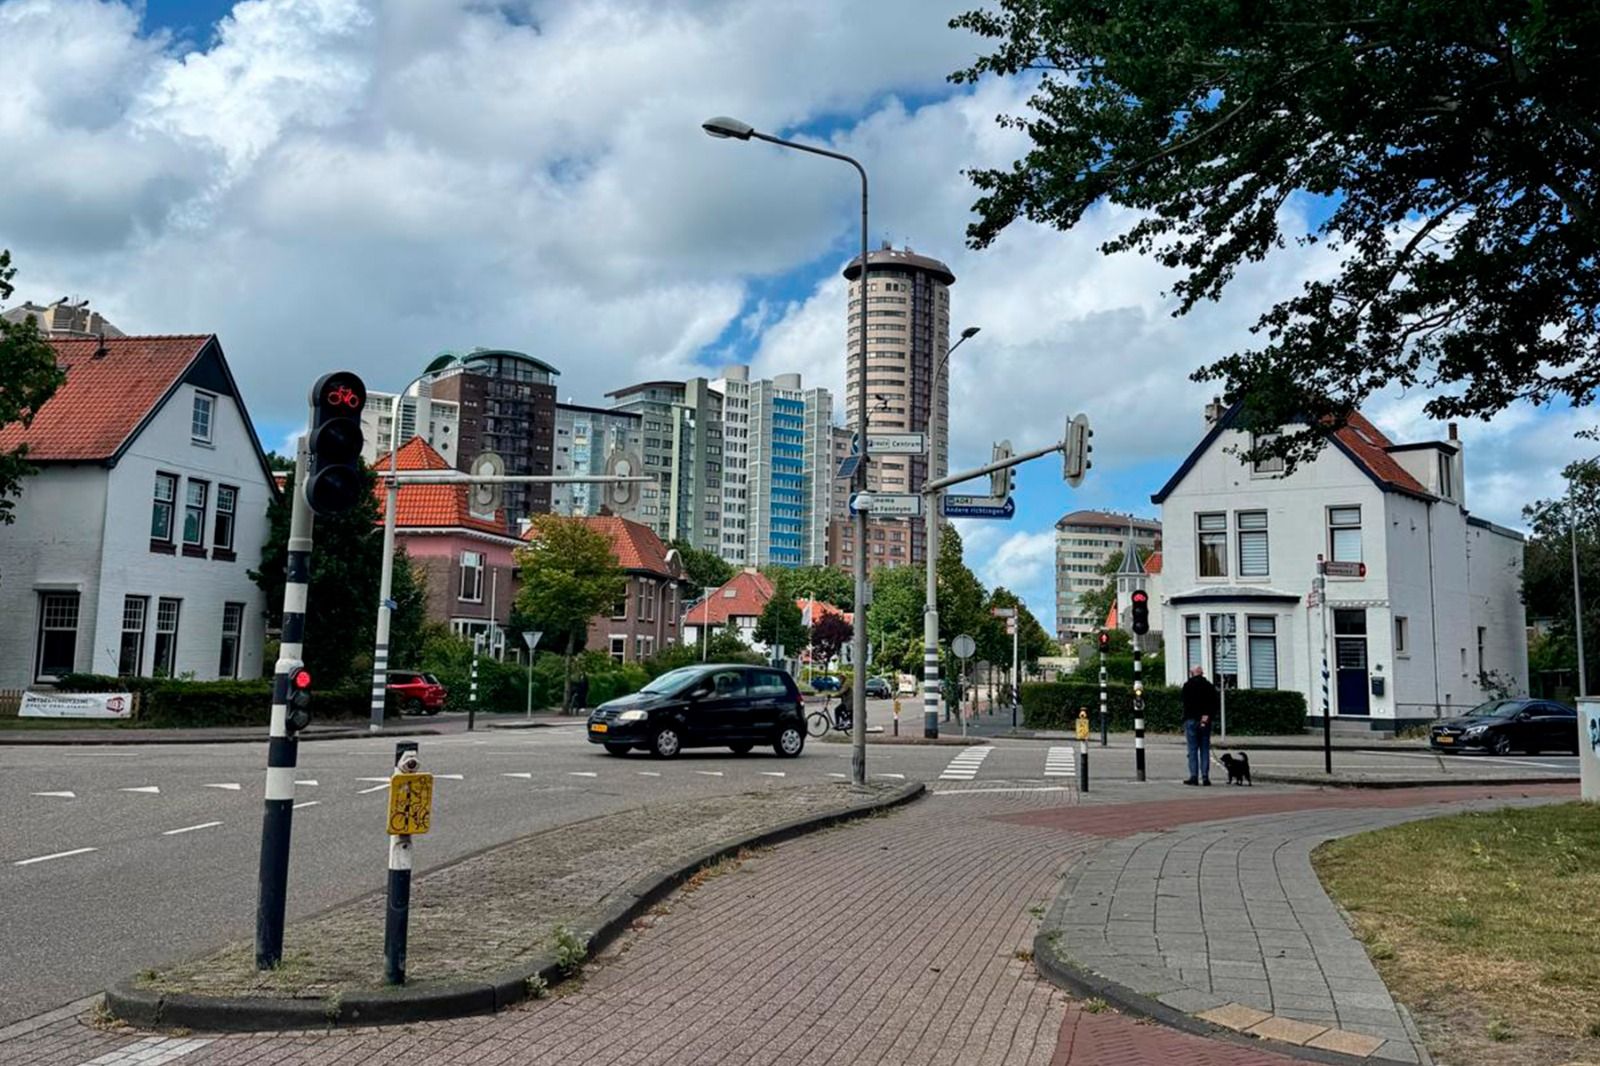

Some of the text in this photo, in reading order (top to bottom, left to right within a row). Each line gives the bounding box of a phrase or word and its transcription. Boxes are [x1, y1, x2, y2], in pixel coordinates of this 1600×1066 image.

[891, 440, 921, 448] Centrum
[946, 506, 1004, 516] Andere richtingen
